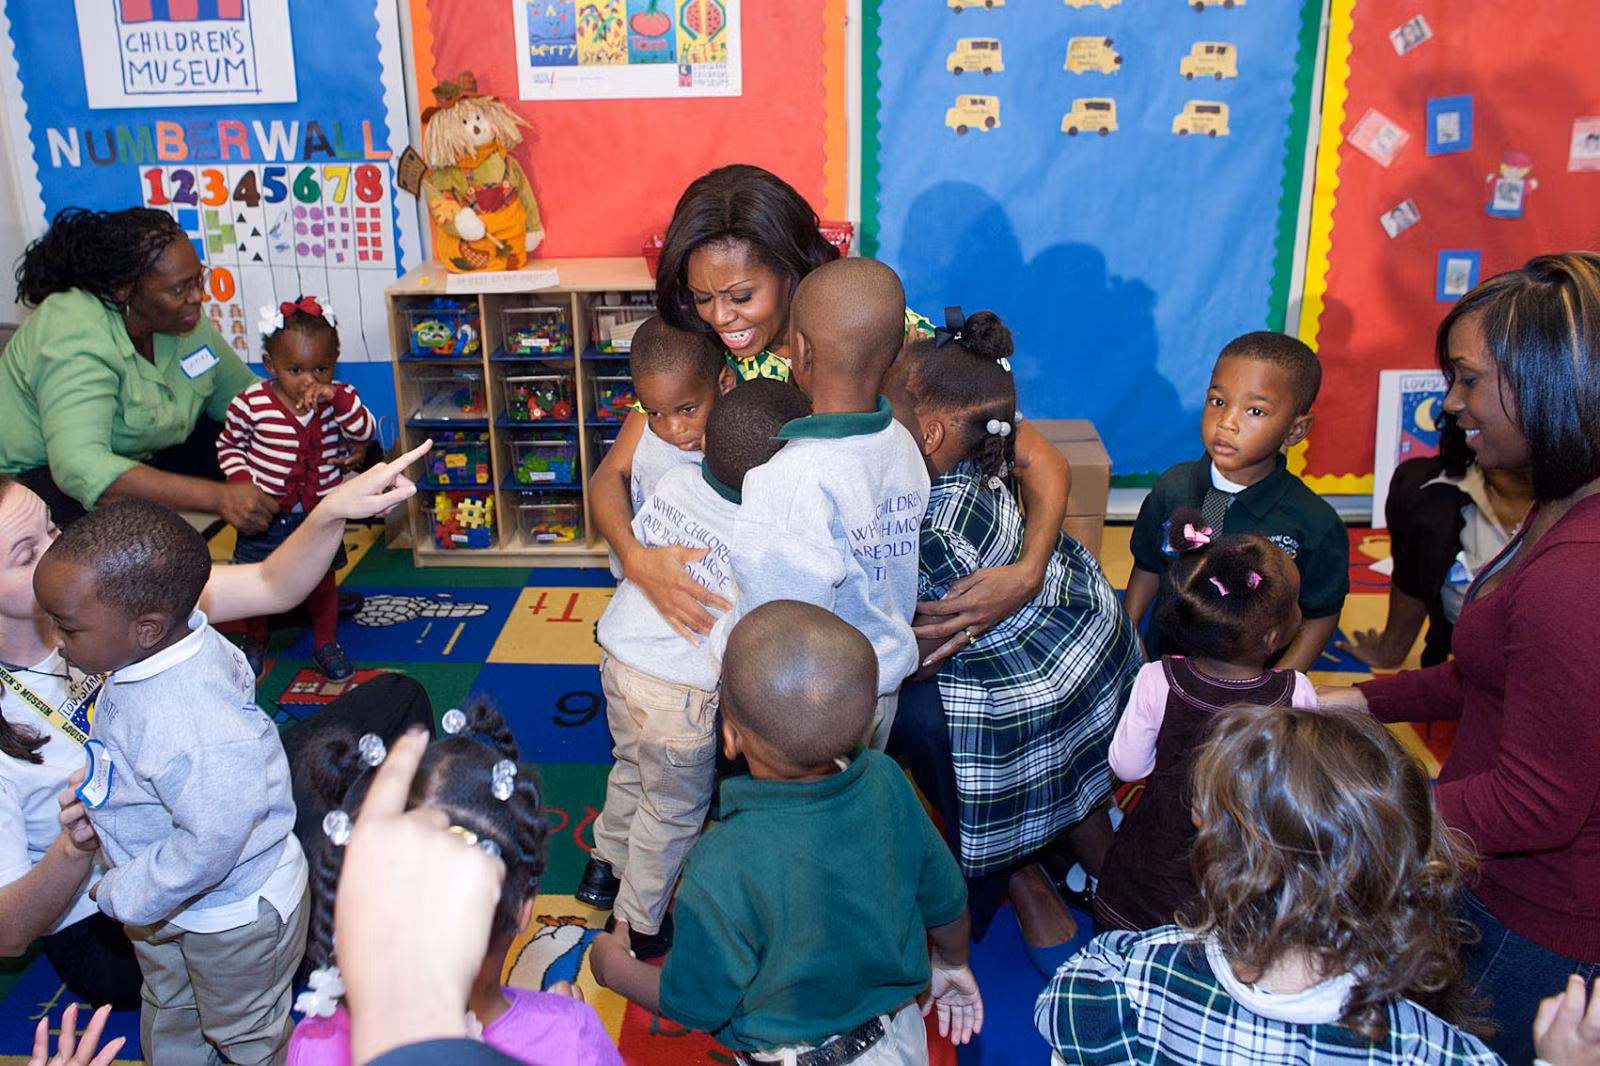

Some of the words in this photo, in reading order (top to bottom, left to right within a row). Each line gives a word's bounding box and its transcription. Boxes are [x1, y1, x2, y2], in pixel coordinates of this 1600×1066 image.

[125, 26, 245, 54] CHILDREN'S
[128, 58, 249, 87] MUSEUM
[46, 120, 250, 168] NUMBER
[252, 119, 393, 162] WALL
[144, 168, 169, 206] 1
[170, 169, 199, 206] 2
[200, 169, 228, 206] 3
[232, 169, 261, 207] 4
[262, 166, 288, 204] 5
[292, 166, 321, 204] 6
[323, 166, 352, 203] 7
[354, 164, 384, 203] 8
[652, 495, 687, 528] WHERE
[684, 522, 732, 564] CHILDRE
[642, 514, 663, 534] ARE
[700, 556, 731, 590] MORE
[20, 688, 53, 717] MUSEUM
